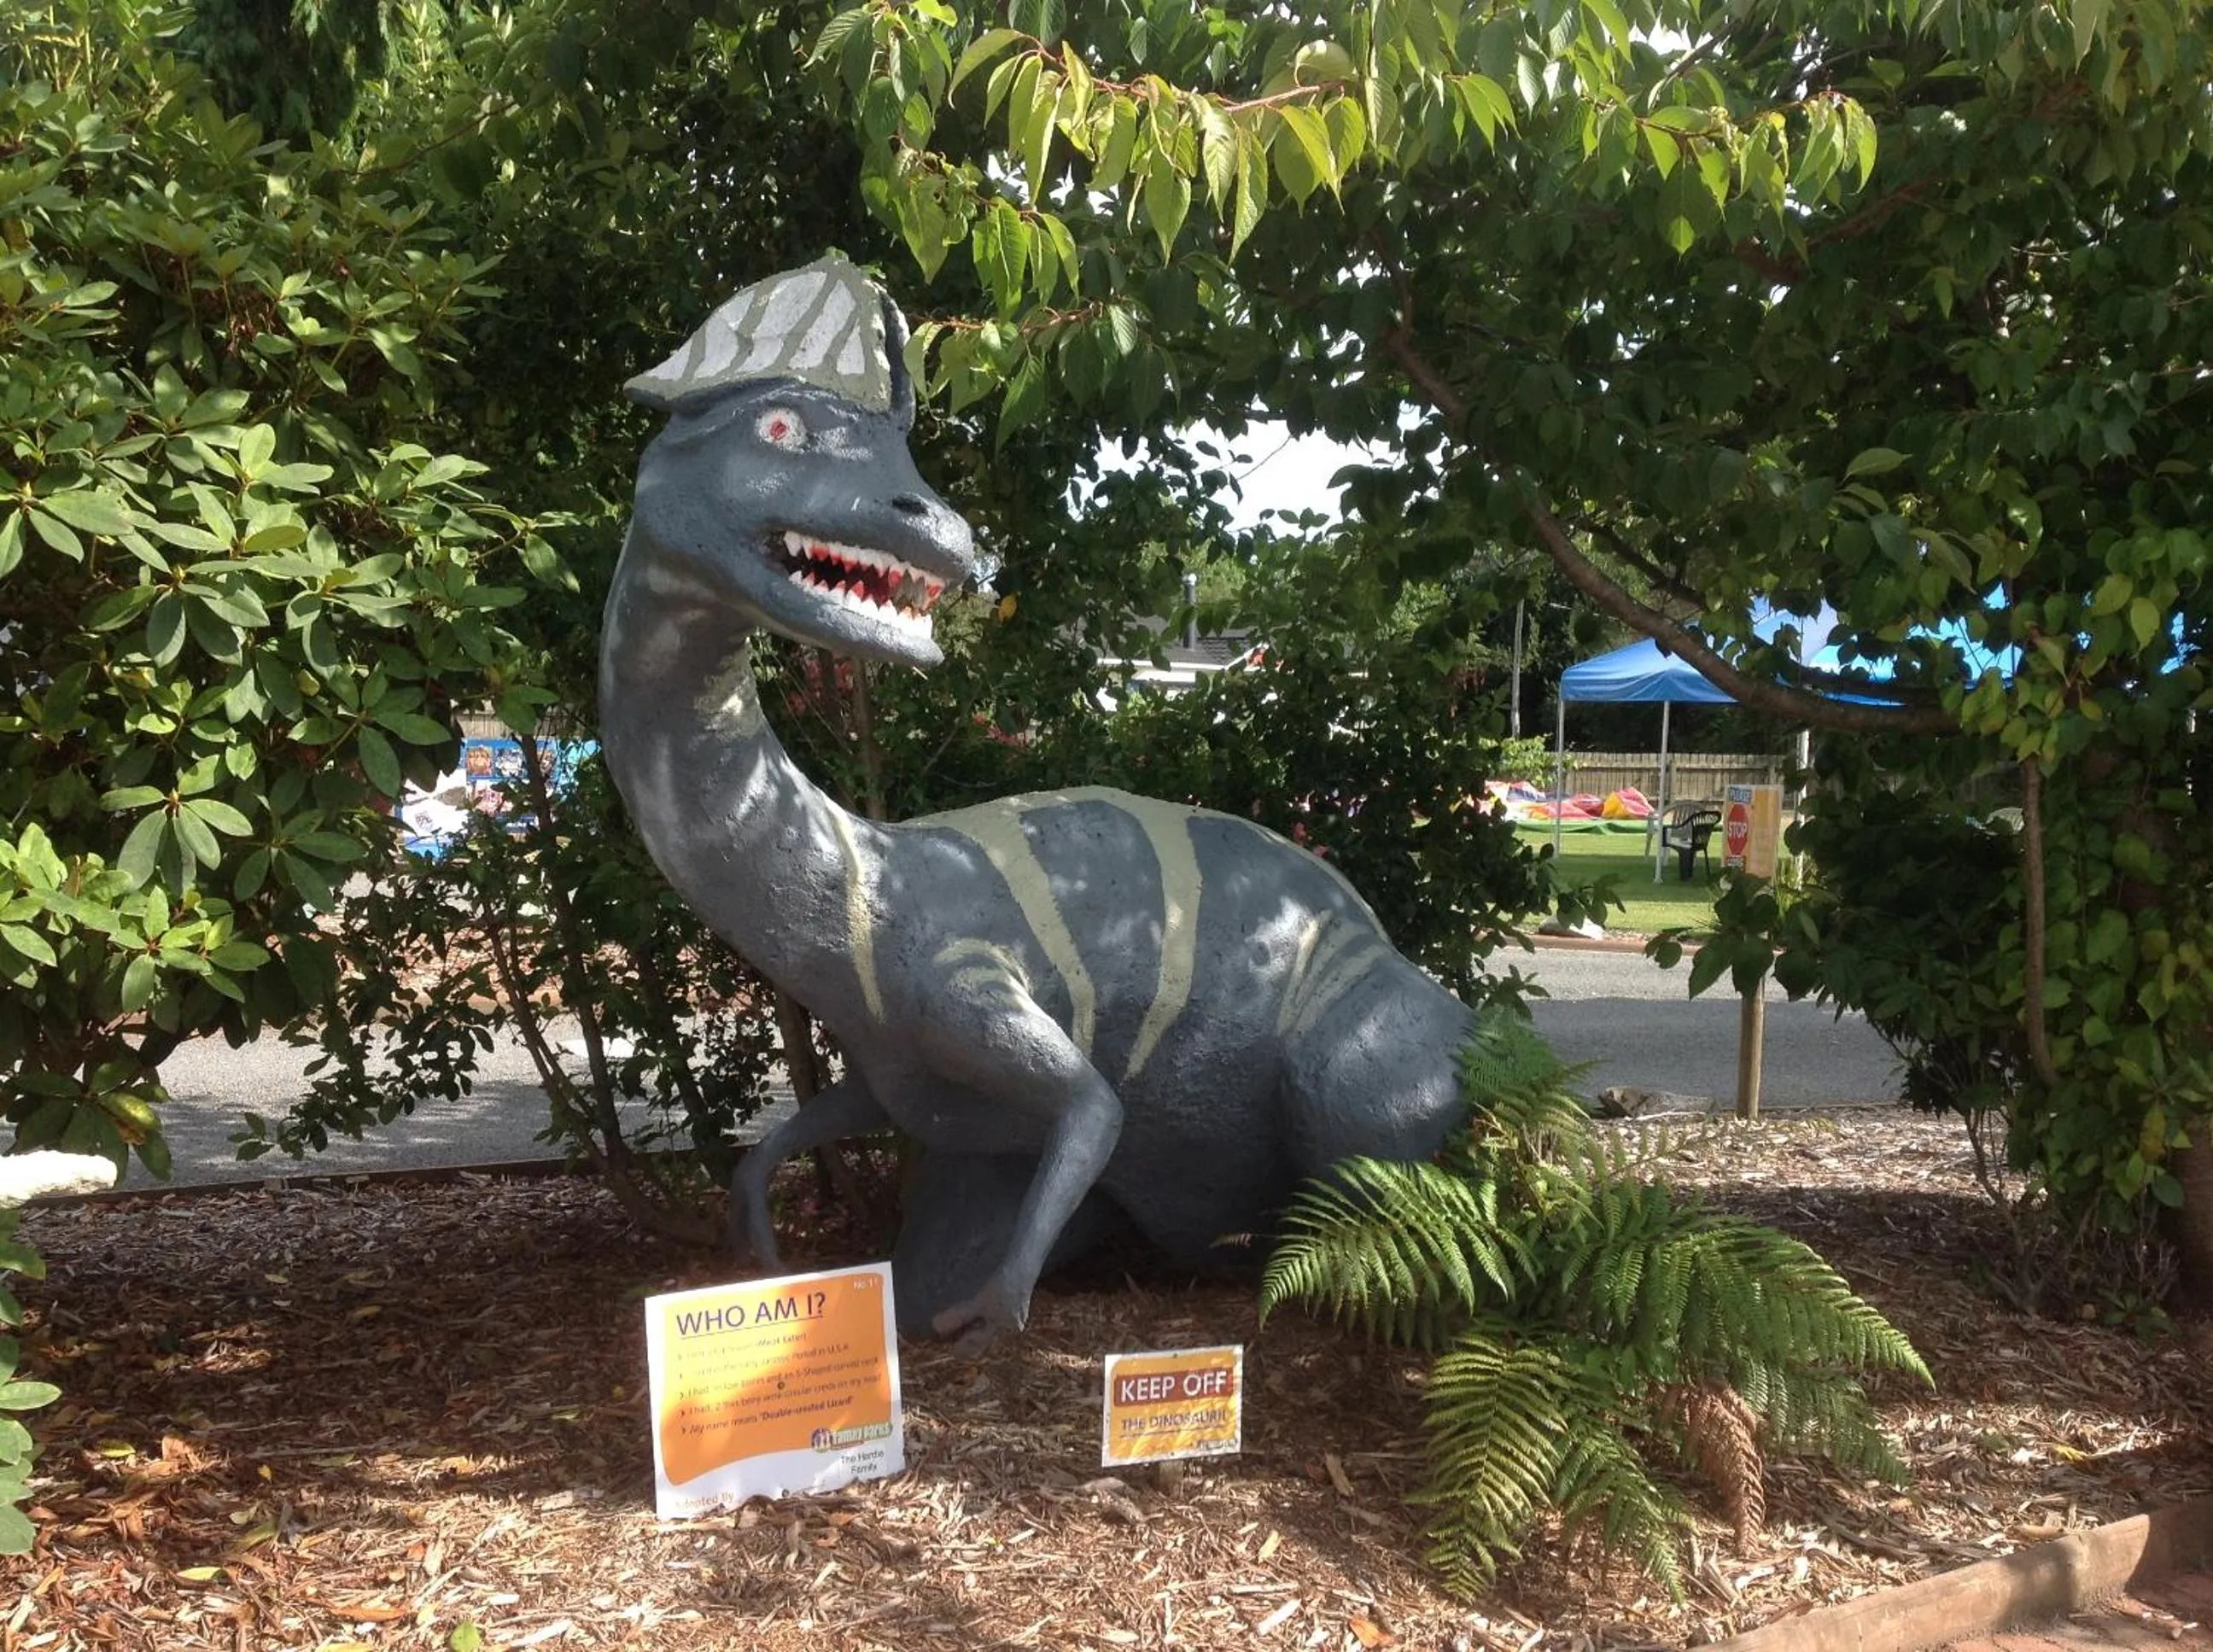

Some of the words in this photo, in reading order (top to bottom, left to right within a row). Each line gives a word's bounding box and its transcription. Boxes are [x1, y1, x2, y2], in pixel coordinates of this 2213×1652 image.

[1728, 821, 1747, 838] STOP
[676, 1305, 744, 1335] WHO
[755, 1297, 797, 1323] AM
[807, 1291, 826, 1316] I?
[1121, 1375, 1176, 1402] KEEP
[1183, 1370, 1227, 1396] OFF
[1121, 1416, 1146, 1432] THE
